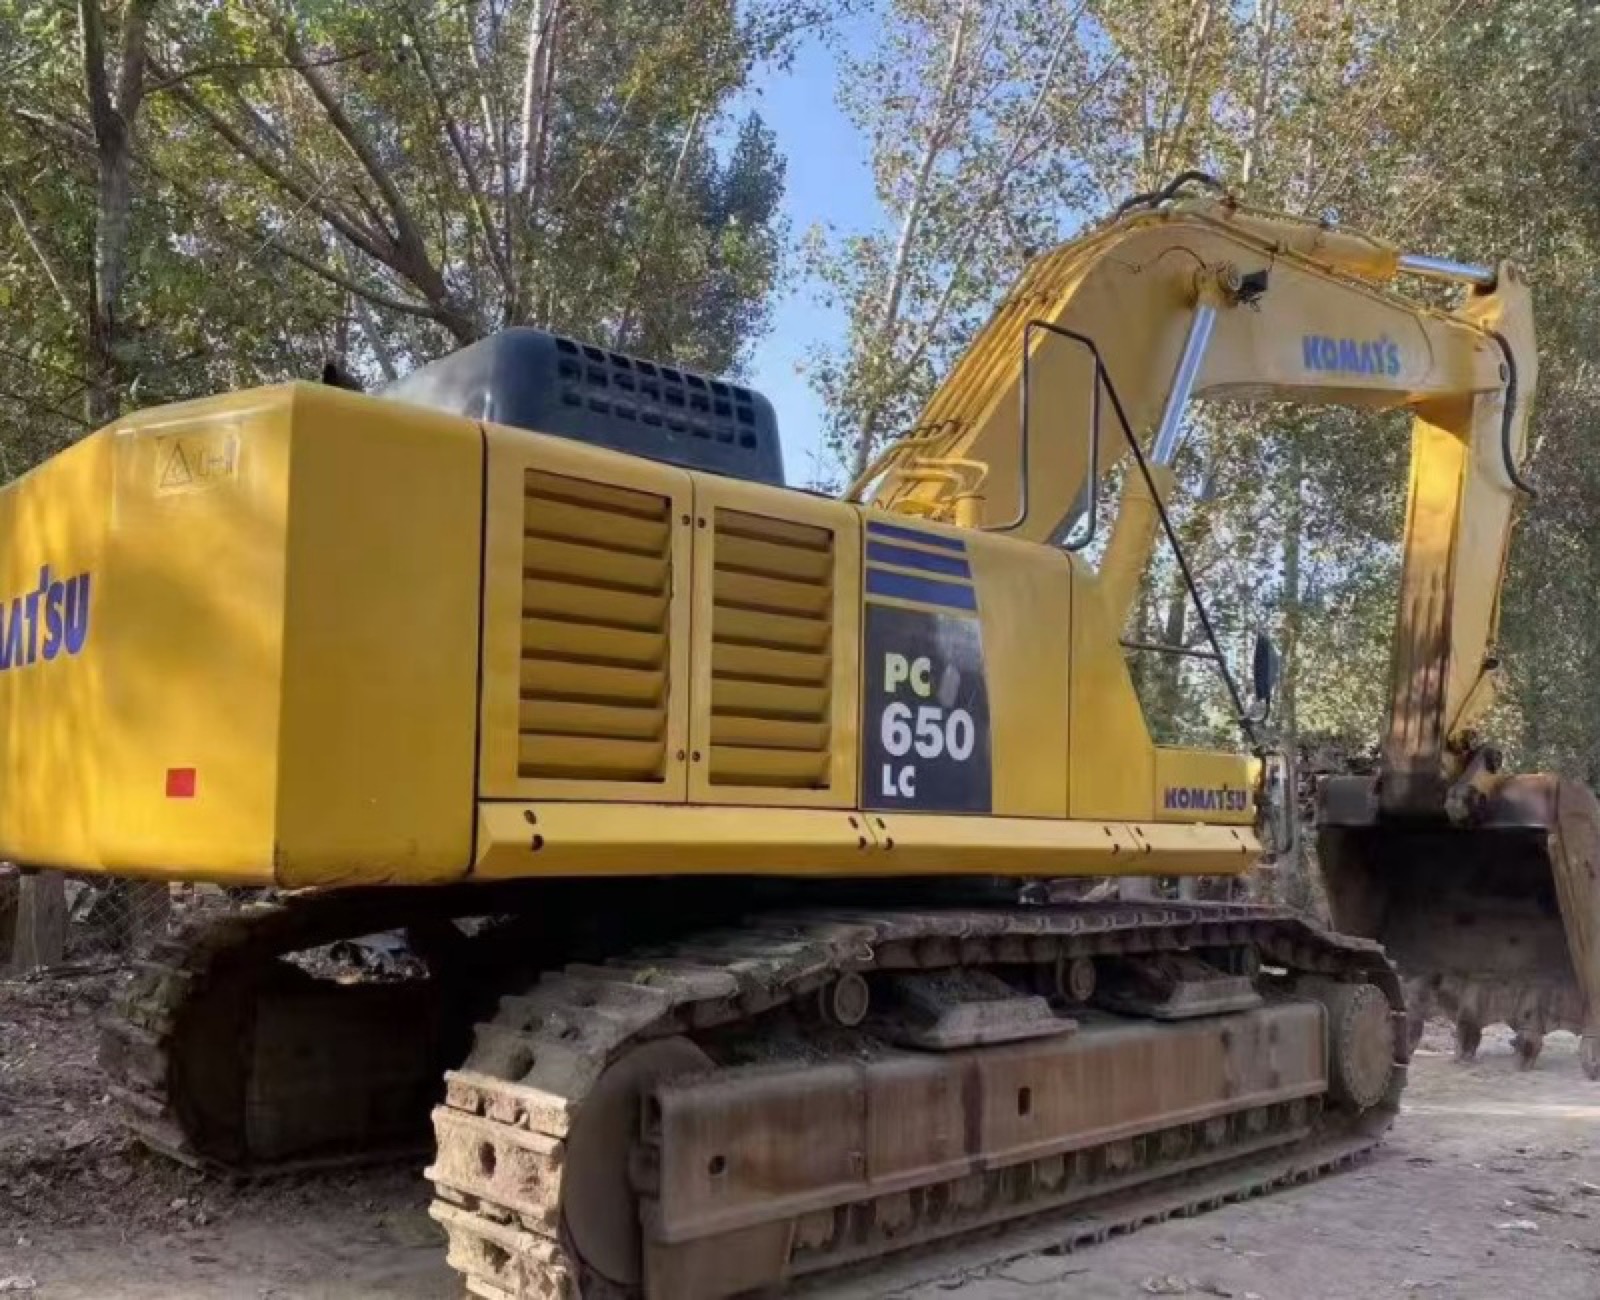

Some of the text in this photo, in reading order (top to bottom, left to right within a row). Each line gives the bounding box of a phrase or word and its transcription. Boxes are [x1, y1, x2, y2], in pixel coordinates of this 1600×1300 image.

[0, 564, 90, 670] ATSU
[884, 653, 931, 697] PC
[882, 702, 975, 761] 650
[882, 763, 916, 798] LC
[1164, 784, 1247, 811] KOMATSU
